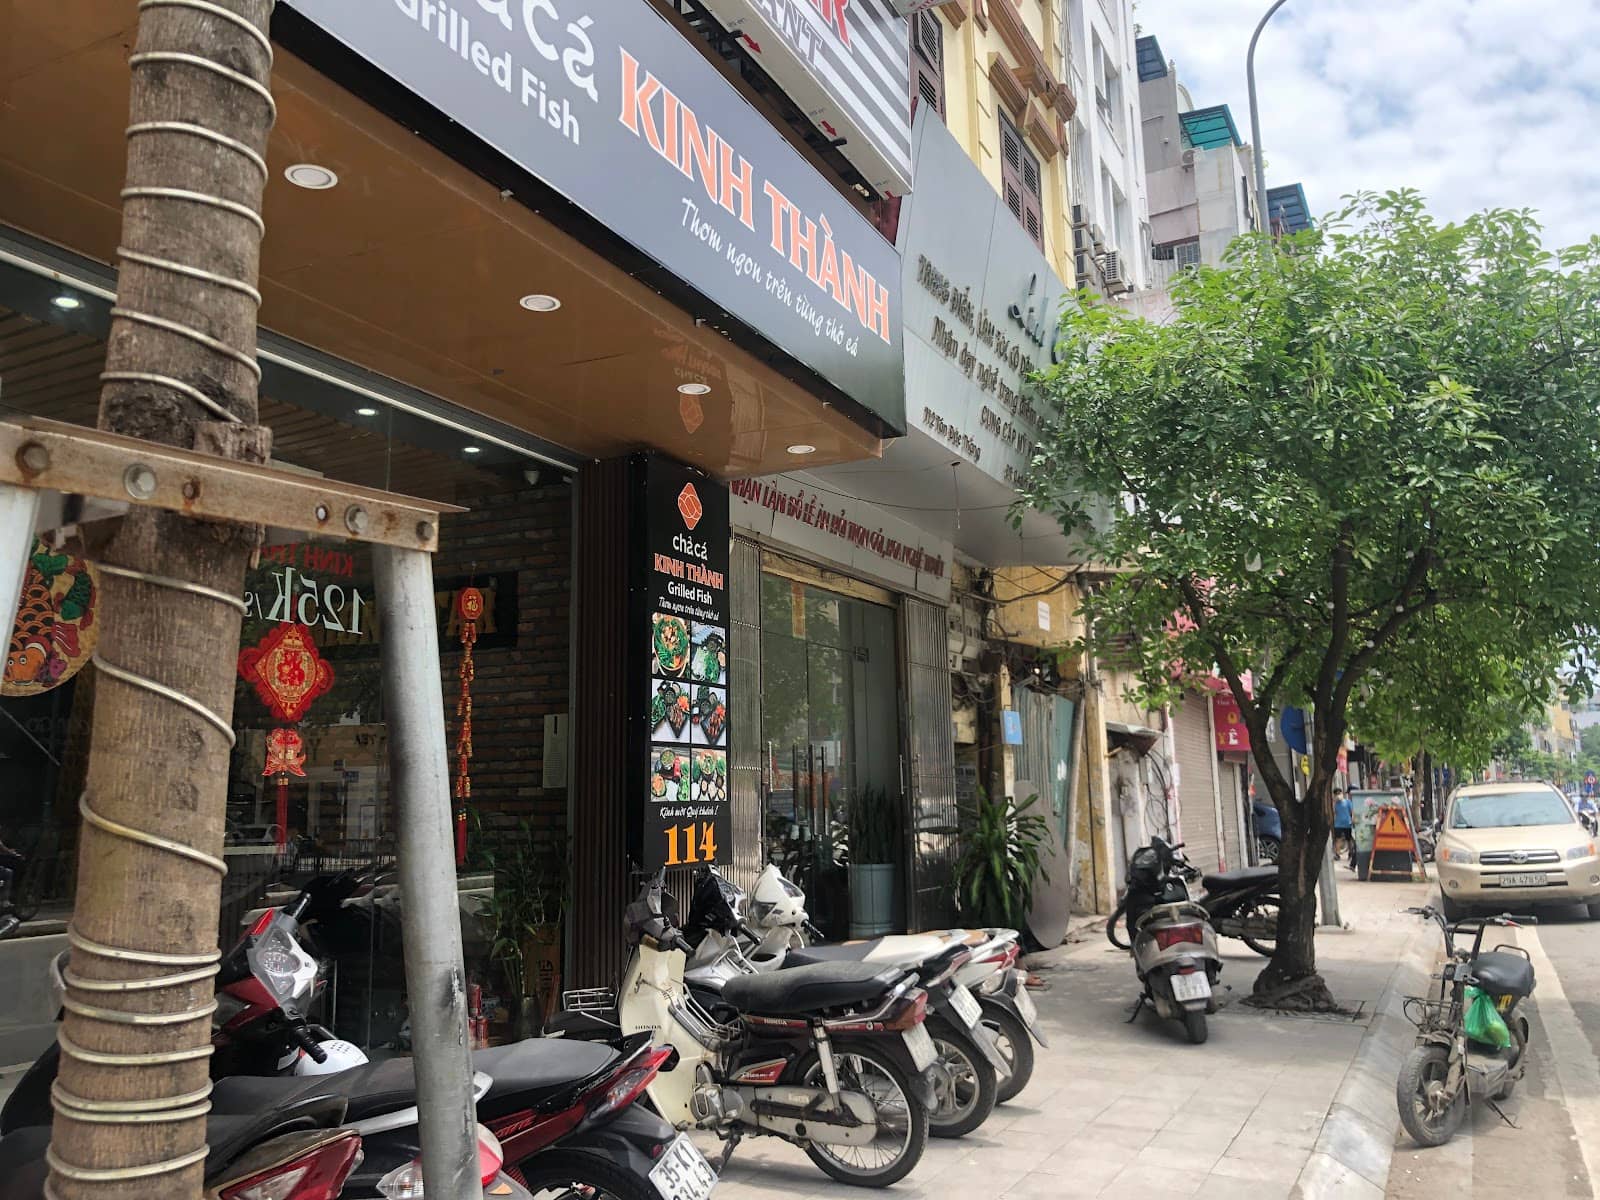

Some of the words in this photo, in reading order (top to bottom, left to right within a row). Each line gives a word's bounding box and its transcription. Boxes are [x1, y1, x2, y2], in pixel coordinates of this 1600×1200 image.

[521, 66, 580, 145] Fish
[618, 45, 756, 233] KINH
[763, 178, 892, 346] THÀNH
[681, 197, 722, 252] Thơm
[726, 242, 762, 283] ngon
[765, 271, 793, 307] trên
[845, 335, 860, 357] cá
[653, 552, 685, 579] KINH
[685, 562, 724, 591] THÀNH
[667, 580, 696, 601] Grilled
[696, 588, 713, 606] Fish
[663, 821, 718, 866] 114
